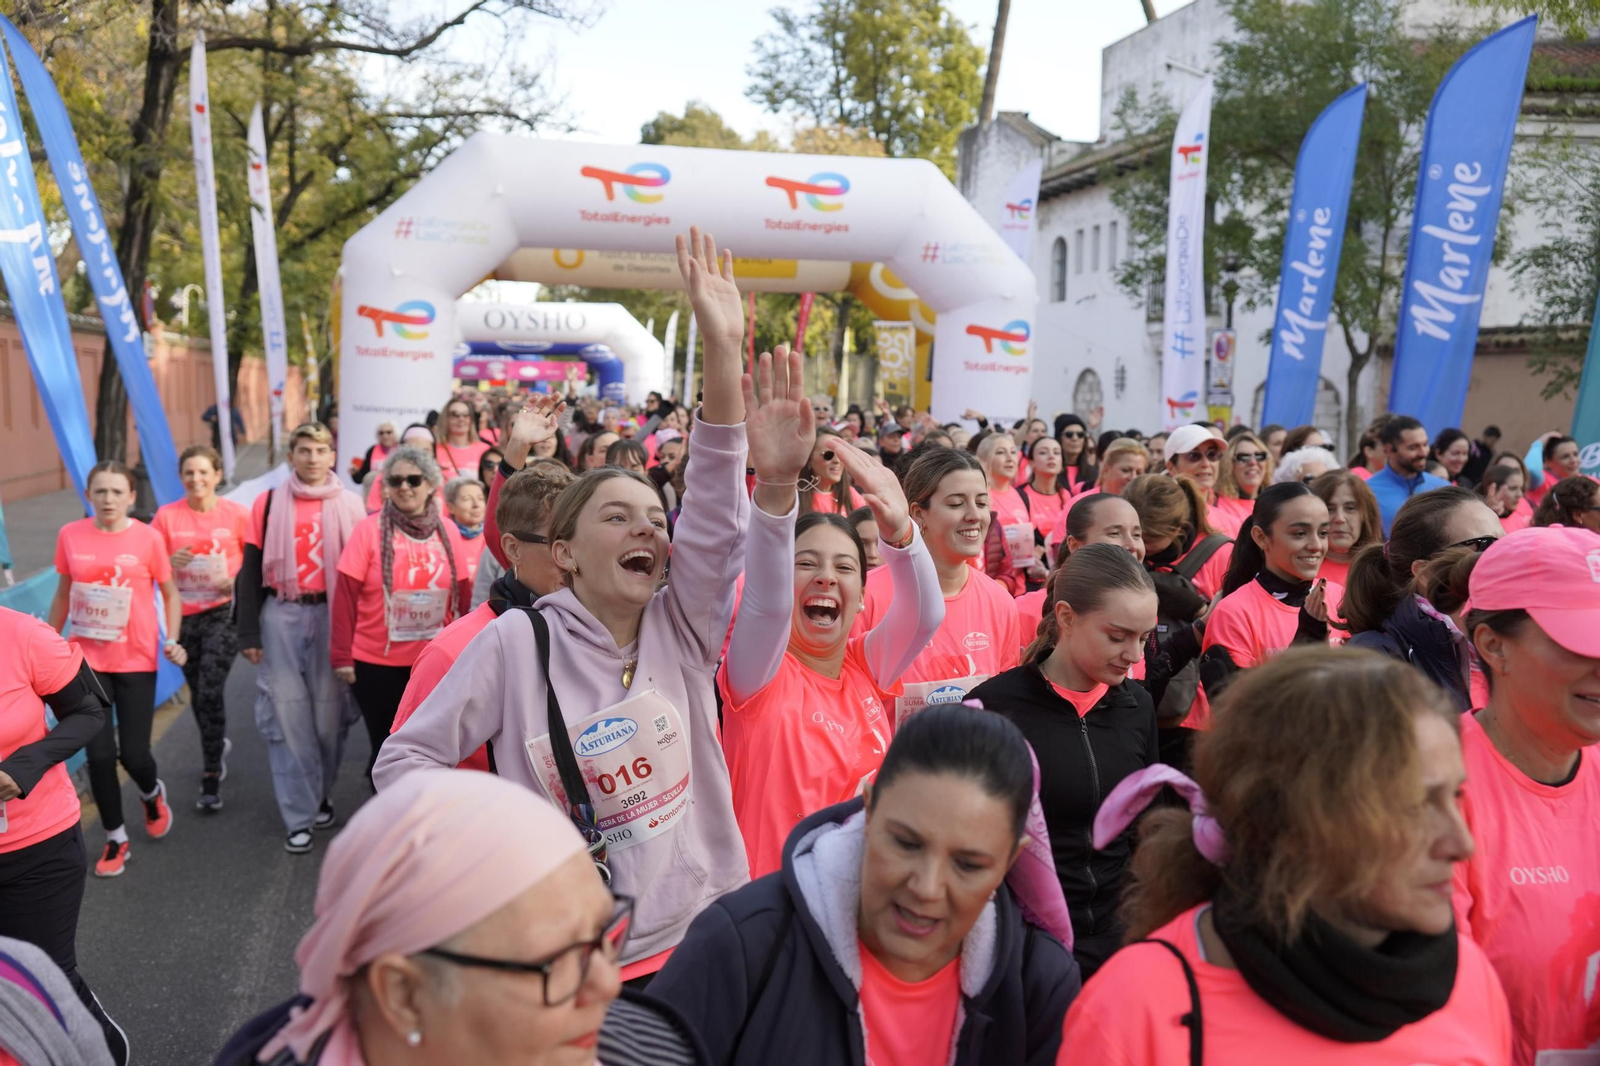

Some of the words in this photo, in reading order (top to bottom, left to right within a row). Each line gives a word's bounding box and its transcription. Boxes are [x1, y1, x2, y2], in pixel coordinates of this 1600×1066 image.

[579, 209, 670, 226] TotalEnergies
[764, 218, 850, 235] TotalEnergies
[1410, 161, 1492, 342] Marlene
[1278, 206, 1332, 361] Marlene
[484, 310, 586, 331] OYSHO
[86, 607, 109, 617] 016
[409, 611, 431, 620] 016
[930, 695, 964, 704] ASTURIAN
[580, 725, 635, 754] ASTURIANA
[597, 756, 653, 795] 016
[620, 790, 648, 809] 3692
[617, 815, 626, 823] DE
[626, 811, 636, 819] LA
[636, 800, 659, 815] MUJER
[1510, 865, 1570, 885] OYSHO
